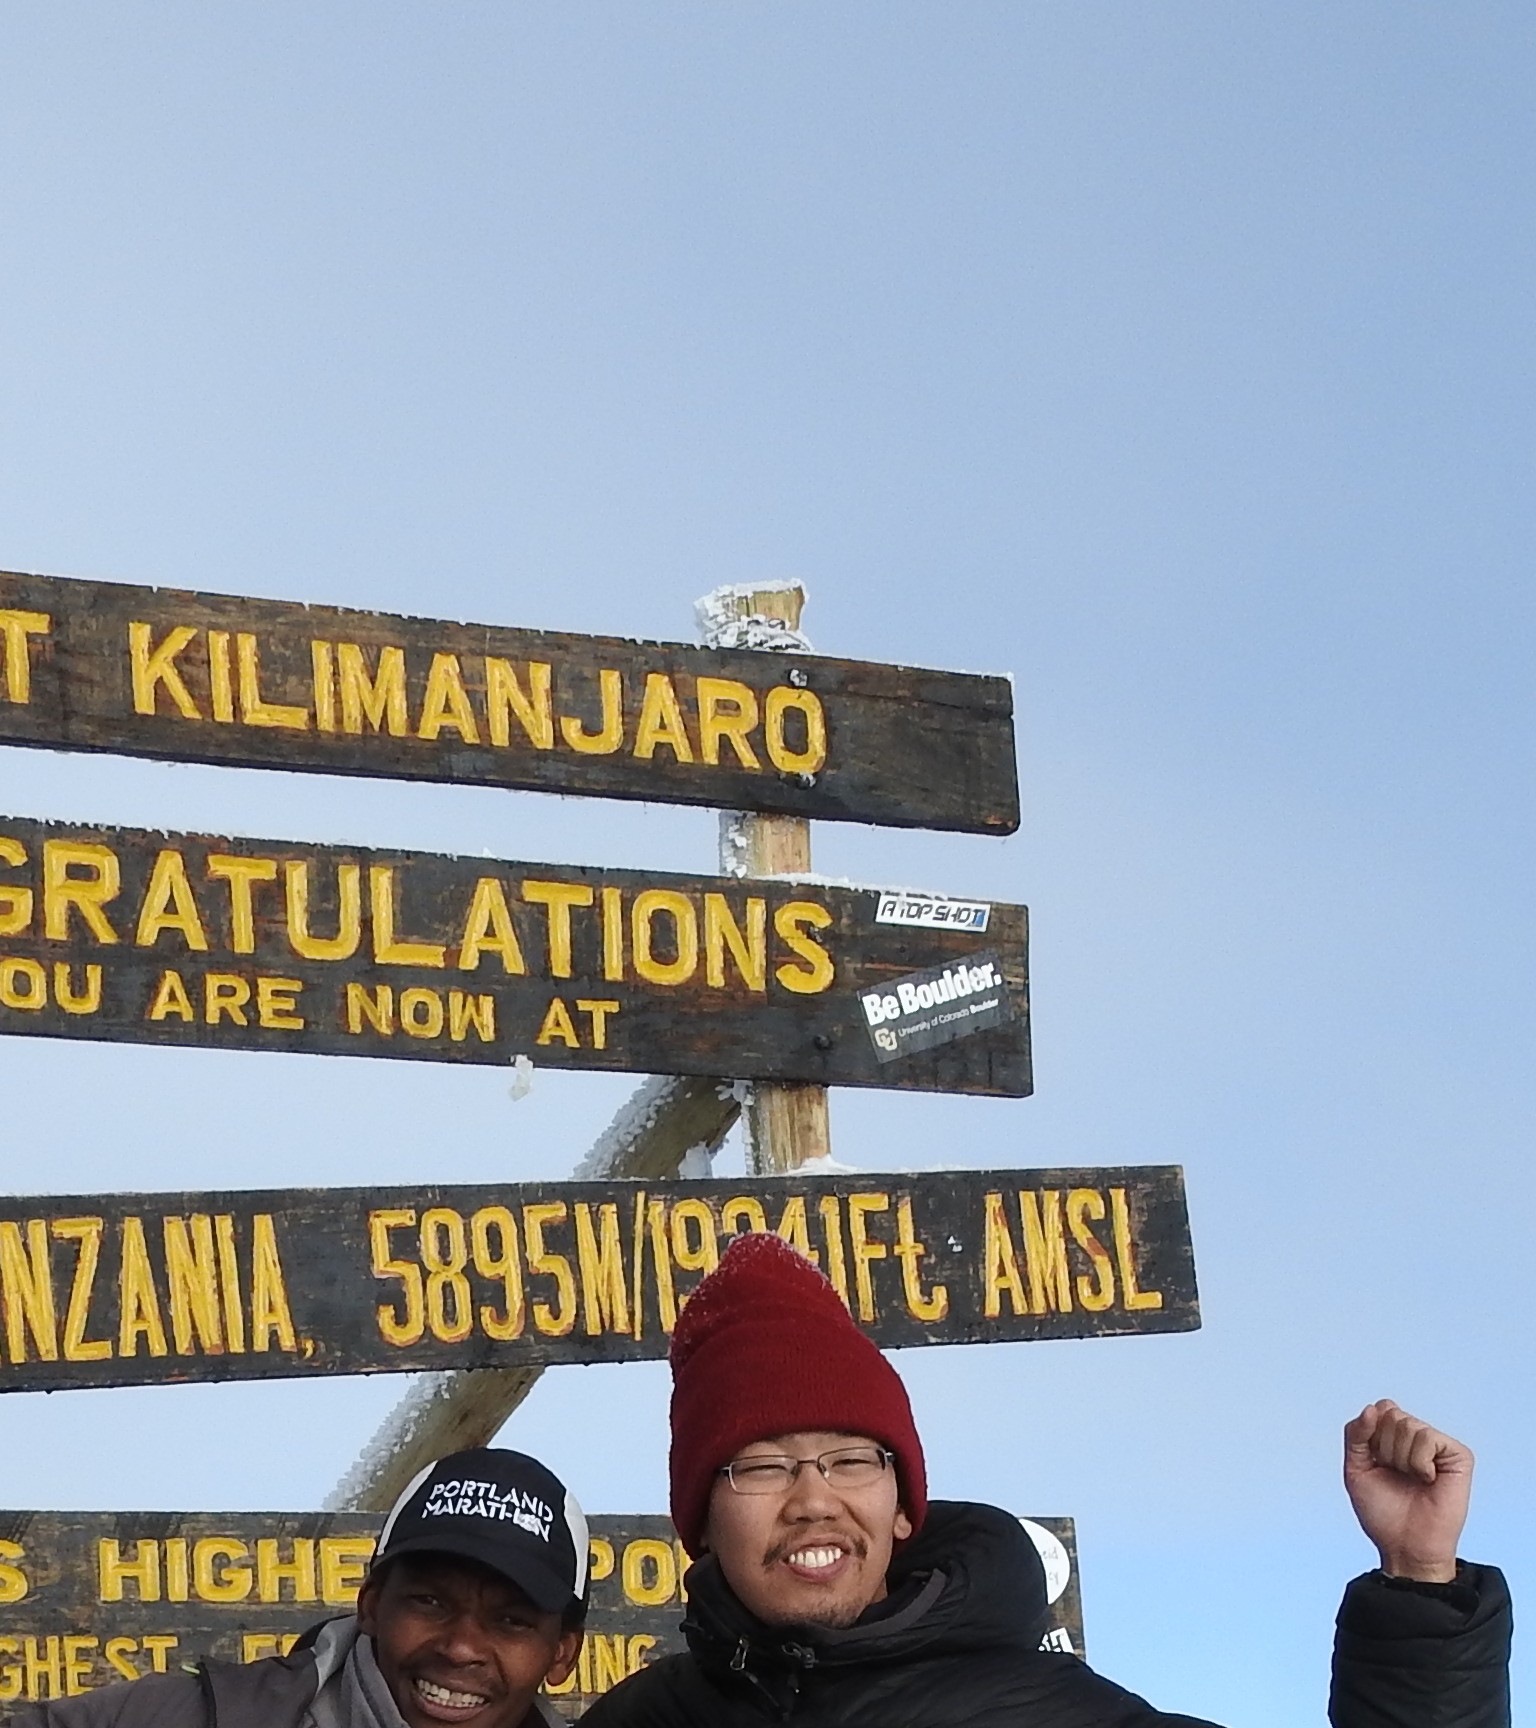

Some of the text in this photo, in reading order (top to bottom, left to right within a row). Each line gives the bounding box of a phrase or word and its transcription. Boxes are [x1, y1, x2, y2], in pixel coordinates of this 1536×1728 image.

[128, 619, 828, 775] KILIMANJARO
[150, 968, 306, 1031] ARE
[346, 982, 496, 1042] NOW
[536, 998, 621, 1050] AT
[862, 962, 1002, 1026] Be Boulder.
[898, 1020, 931, 1037] University
[939, 1008, 970, 1024] Colorado
[970, 998, 1000, 1014] Boulder
[984, 1187, 1162, 1318] AMSL
[429, 1479, 555, 1523] PORTLAND
[98, 1537, 375, 1604] HIGHE
